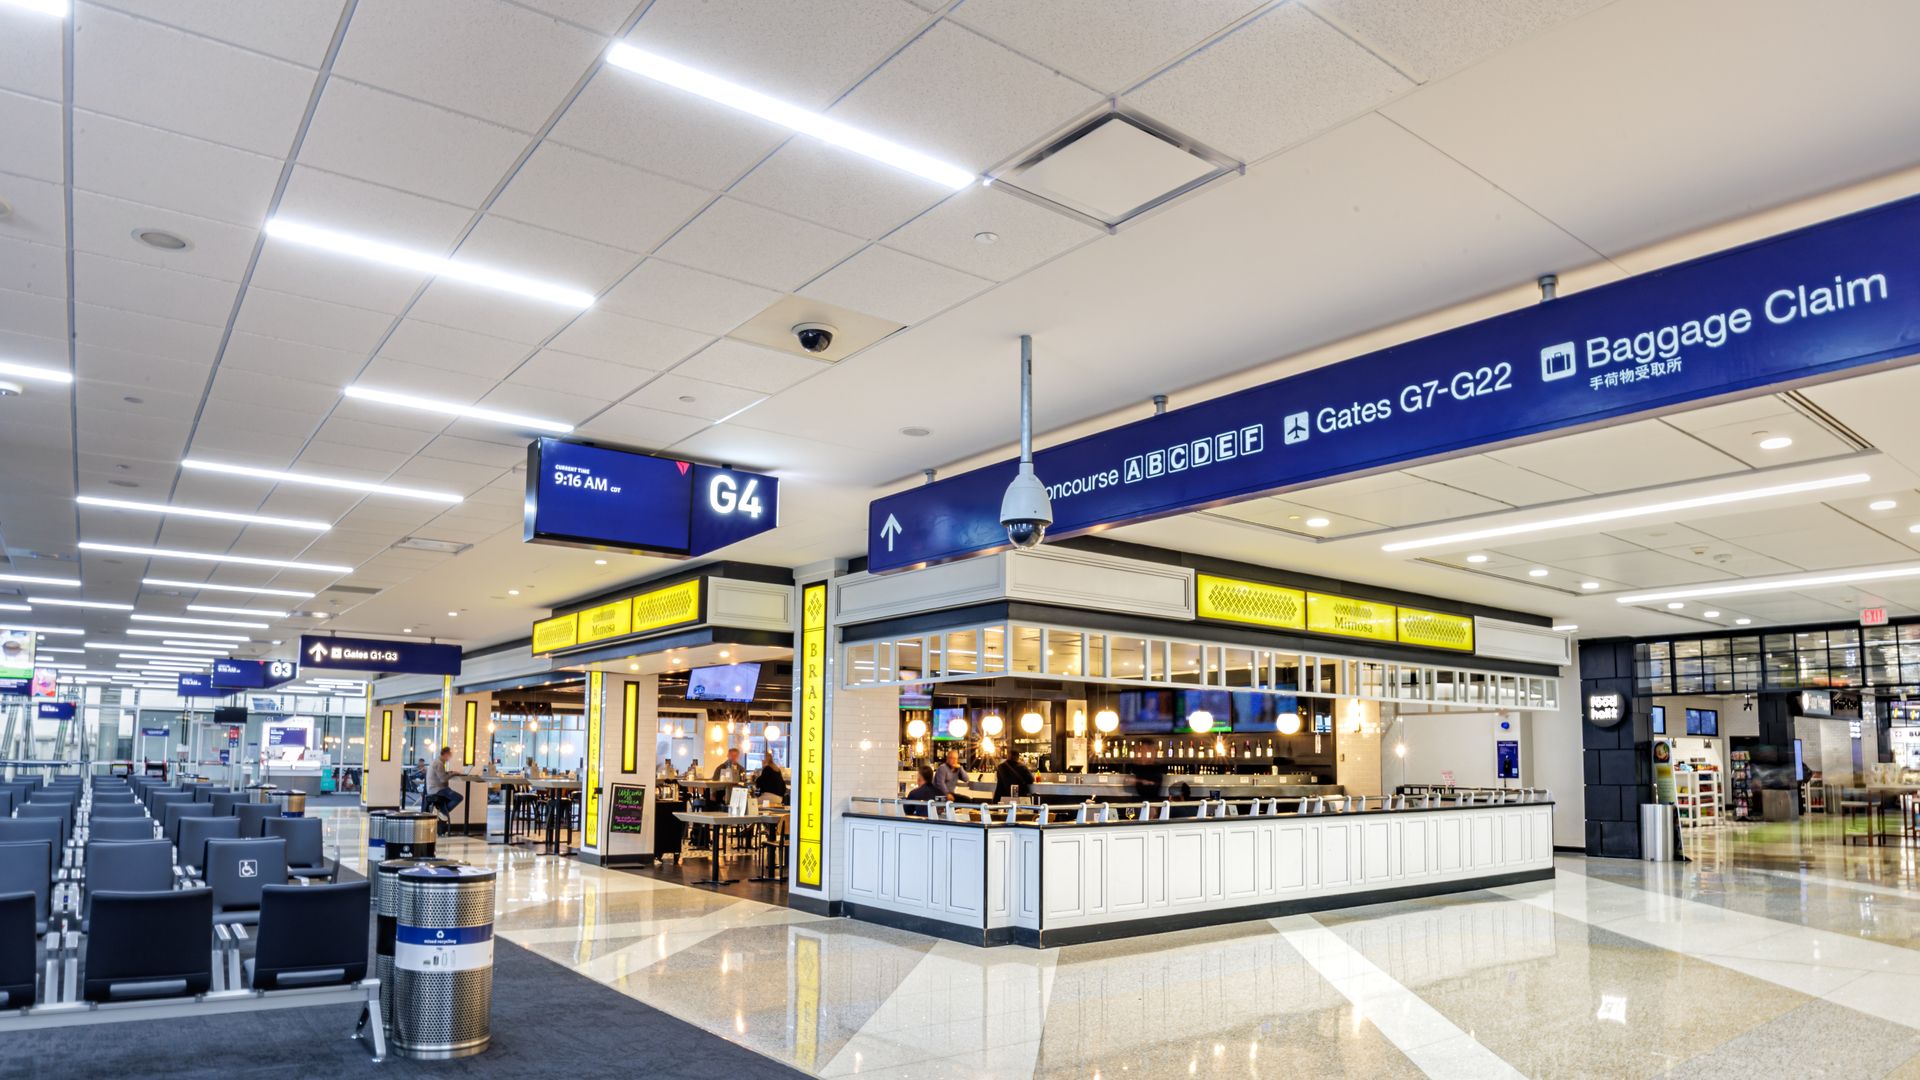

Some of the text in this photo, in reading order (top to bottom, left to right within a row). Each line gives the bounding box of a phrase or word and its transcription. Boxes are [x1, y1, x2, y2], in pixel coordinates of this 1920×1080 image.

[1586, 273, 1888, 369] Baggage Claim
[1590, 357, 1682, 391] 手荷物受取所
[1316, 362, 1512, 433] Gates G7-G22
[555, 464, 590, 475] CURRENT TIME
[554, 471, 582, 488] 9:16
[584, 476, 608, 491] AM
[1045, 469, 1119, 501] oncourse
[709, 474, 762, 518] G4
[1334, 615, 1373, 633] Mimosa
[1864, 609, 1883, 624] EXIT
[592, 623, 615, 637] Mimosa
[343, 649, 398, 661] Gates G1-G3
[271, 662, 292, 677] G3
[806, 642, 818, 828] BRASSERIE
